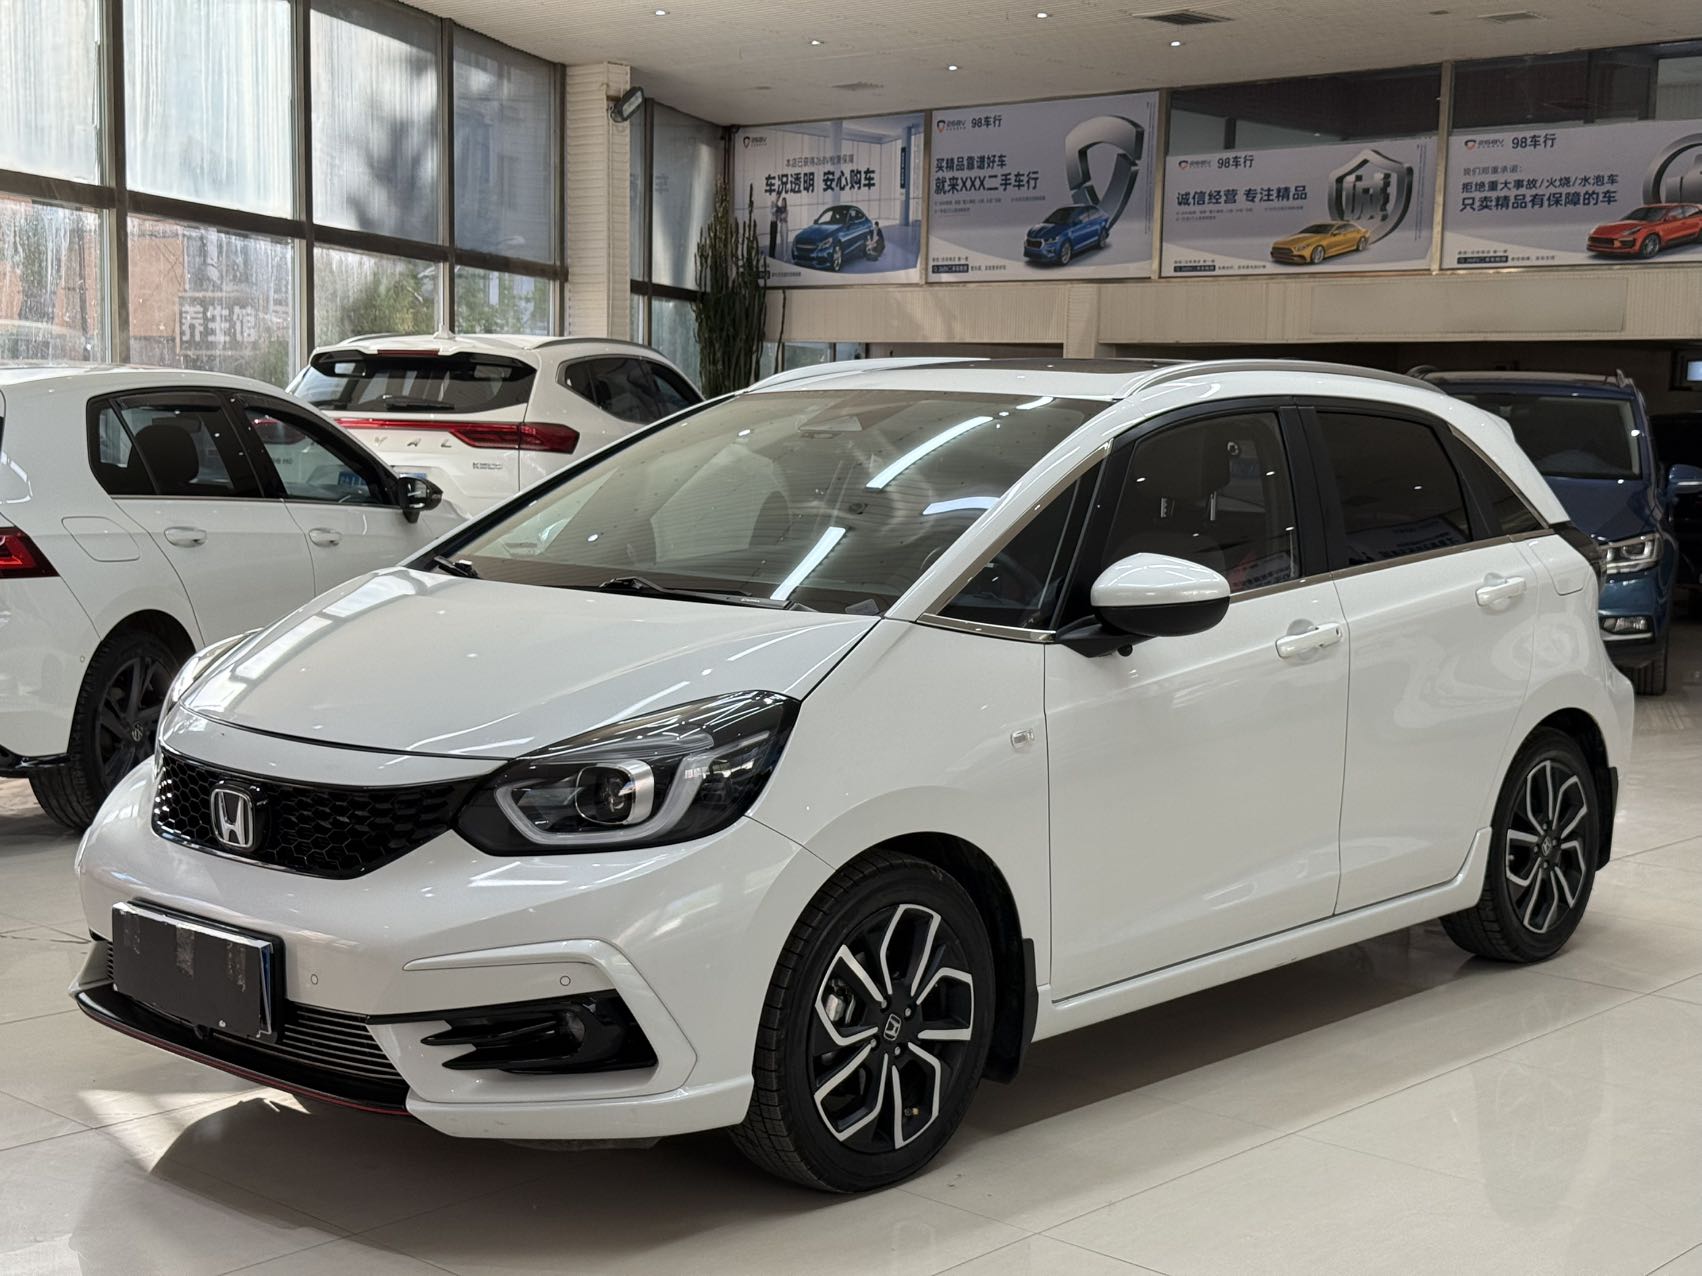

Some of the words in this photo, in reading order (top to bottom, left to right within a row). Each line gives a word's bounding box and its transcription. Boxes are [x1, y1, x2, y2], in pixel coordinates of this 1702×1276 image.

[971, 114, 1002, 129] 98车行
[1511, 133, 1557, 149] 98车行
[935, 154, 1007, 173] 买精品靠谱好车
[1217, 154, 1254, 169] 98车行
[764, 172, 815, 195] 车况透明
[822, 168, 876, 192] 安心购车
[1461, 174, 1619, 193] 拒绝重大事故/火烧/水泡车
[1177, 189, 1238, 206] 诚信经营
[1243, 185, 1308, 203] 专注精品
[1459, 189, 1618, 212] 只卖精品有保障的车
